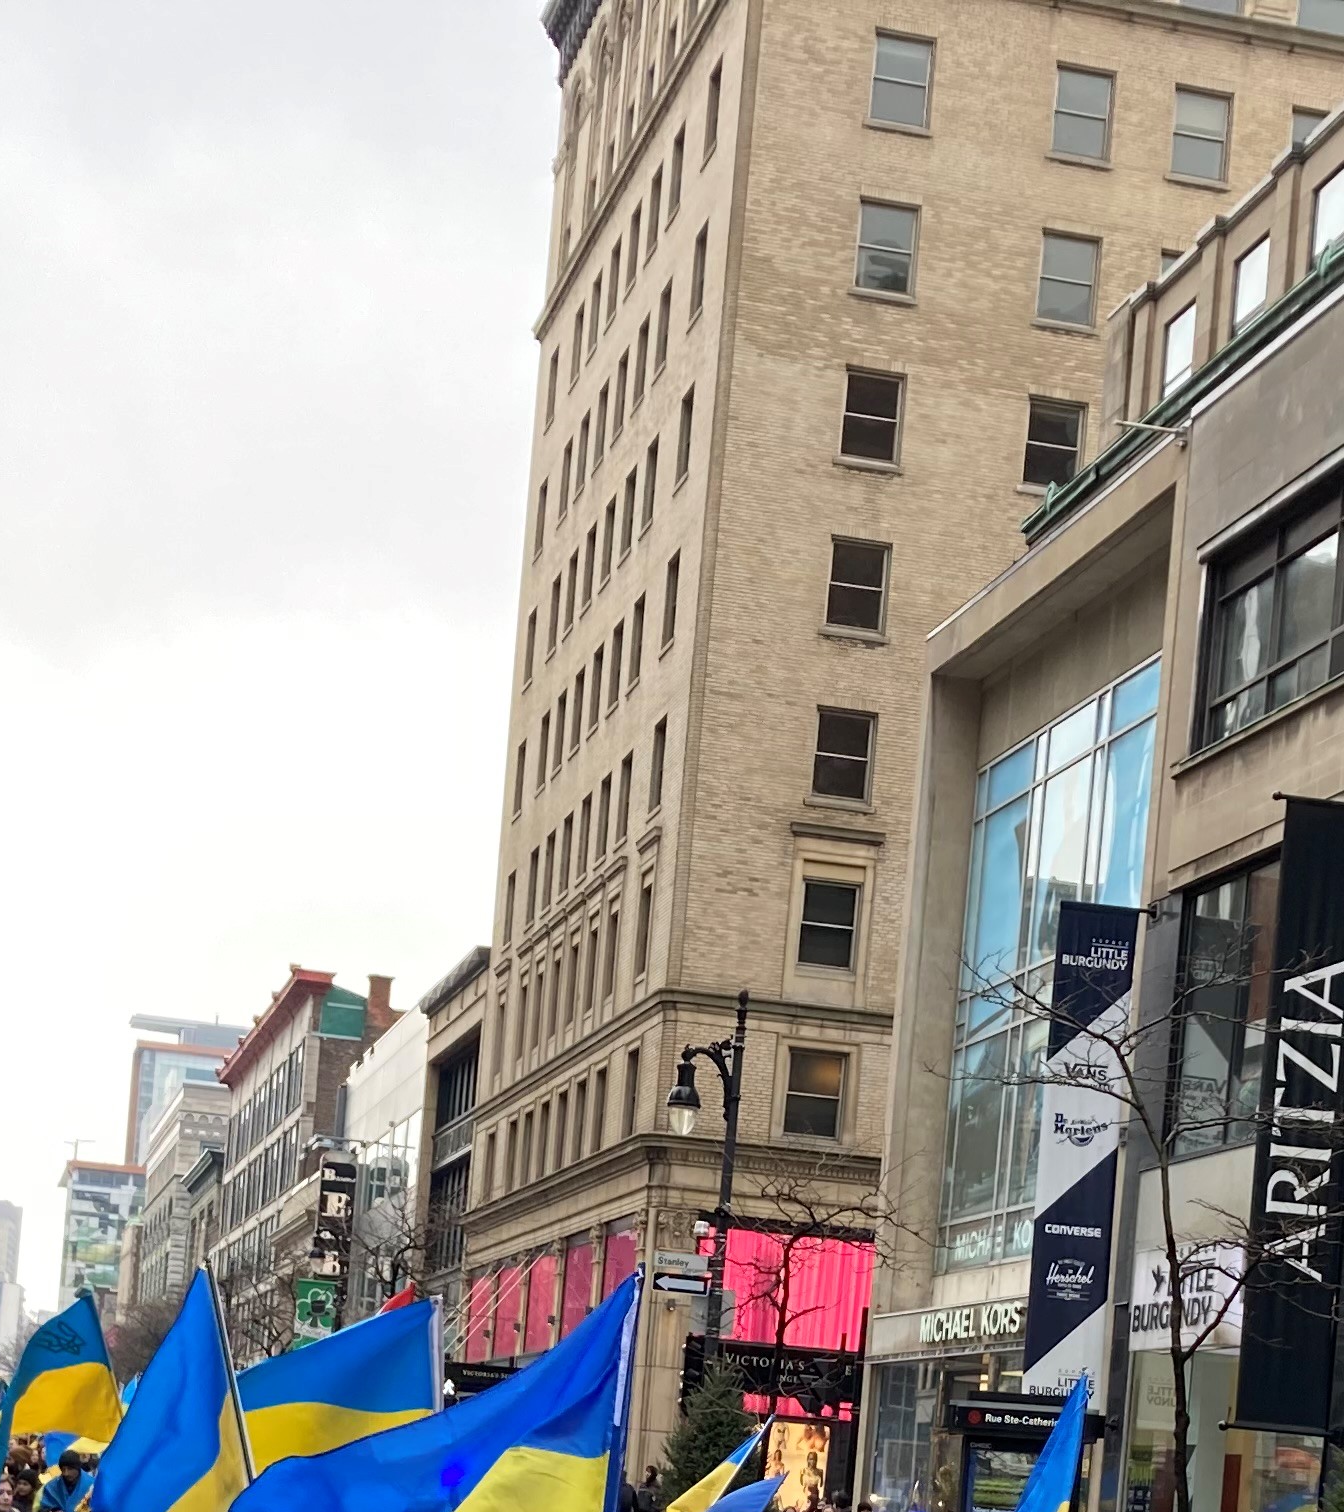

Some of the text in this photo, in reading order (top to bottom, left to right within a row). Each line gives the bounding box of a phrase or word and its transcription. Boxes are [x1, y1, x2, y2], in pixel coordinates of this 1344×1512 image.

[1091, 947, 1129, 960] LITTLE
[1062, 954, 1128, 971] BURGUNDY
[1054, 1122, 1108, 1136] Martens
[1045, 1224, 1102, 1238] CONVERSE
[658, 1256, 689, 1268] Stanley
[1046, 1262, 1095, 1285] Herschel
[1132, 1296, 1212, 1332] BURGNDY
[919, 1301, 1023, 1343] MICHAEL KORS
[985, 1414, 1002, 1423] Rue
